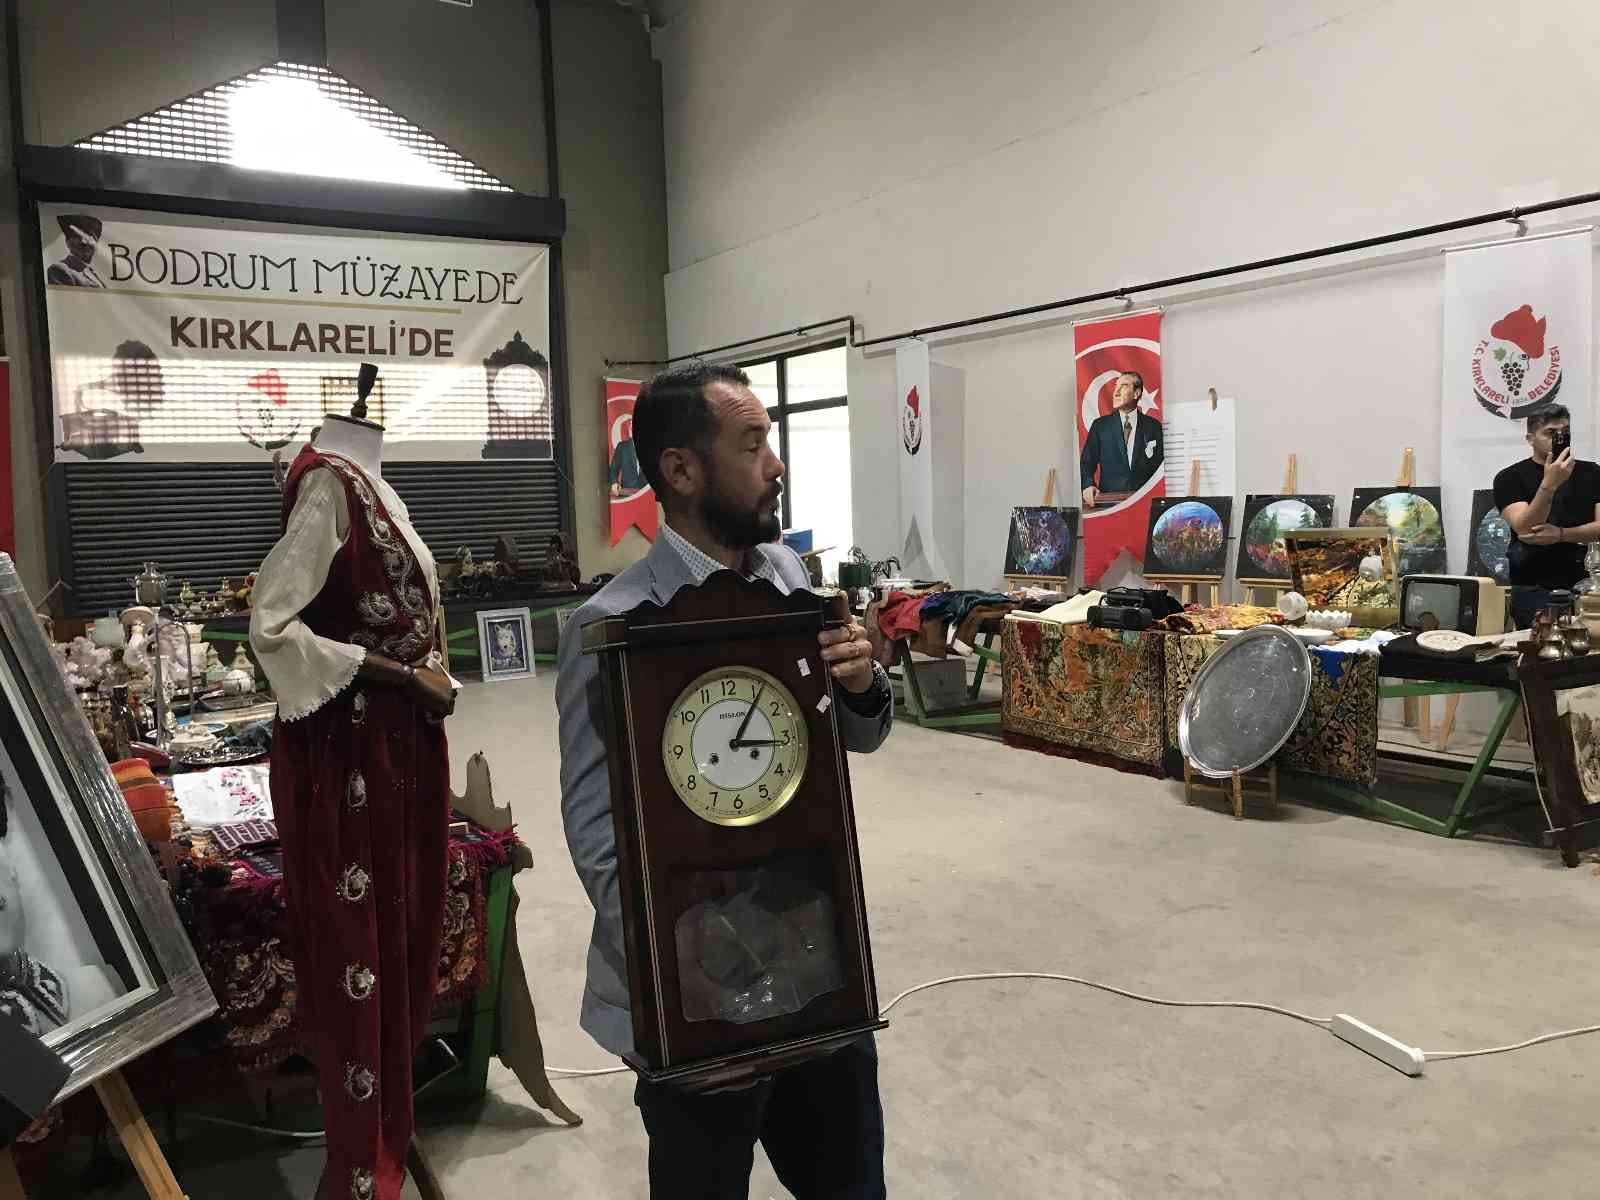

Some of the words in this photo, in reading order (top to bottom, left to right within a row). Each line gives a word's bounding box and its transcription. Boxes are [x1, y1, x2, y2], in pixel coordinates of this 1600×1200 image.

[108, 243, 298, 292] BODRUM
[312, 255, 523, 304] MÜZAYEDE
[170, 316, 454, 357] KIRKLARELİ'DE
[721, 680, 737, 696] 12
[701, 689, 710, 704] 11
[769, 702, 780, 716] 2
[681, 711, 696, 724] 10
[781, 730, 790, 745] 3
[674, 745, 684, 759] 9
[774, 763, 784, 776] 4
[687, 775, 697, 790] 8
[709, 791, 719, 806] 7
[758, 784, 769, 798] 5
[733, 794, 743, 809] 6
